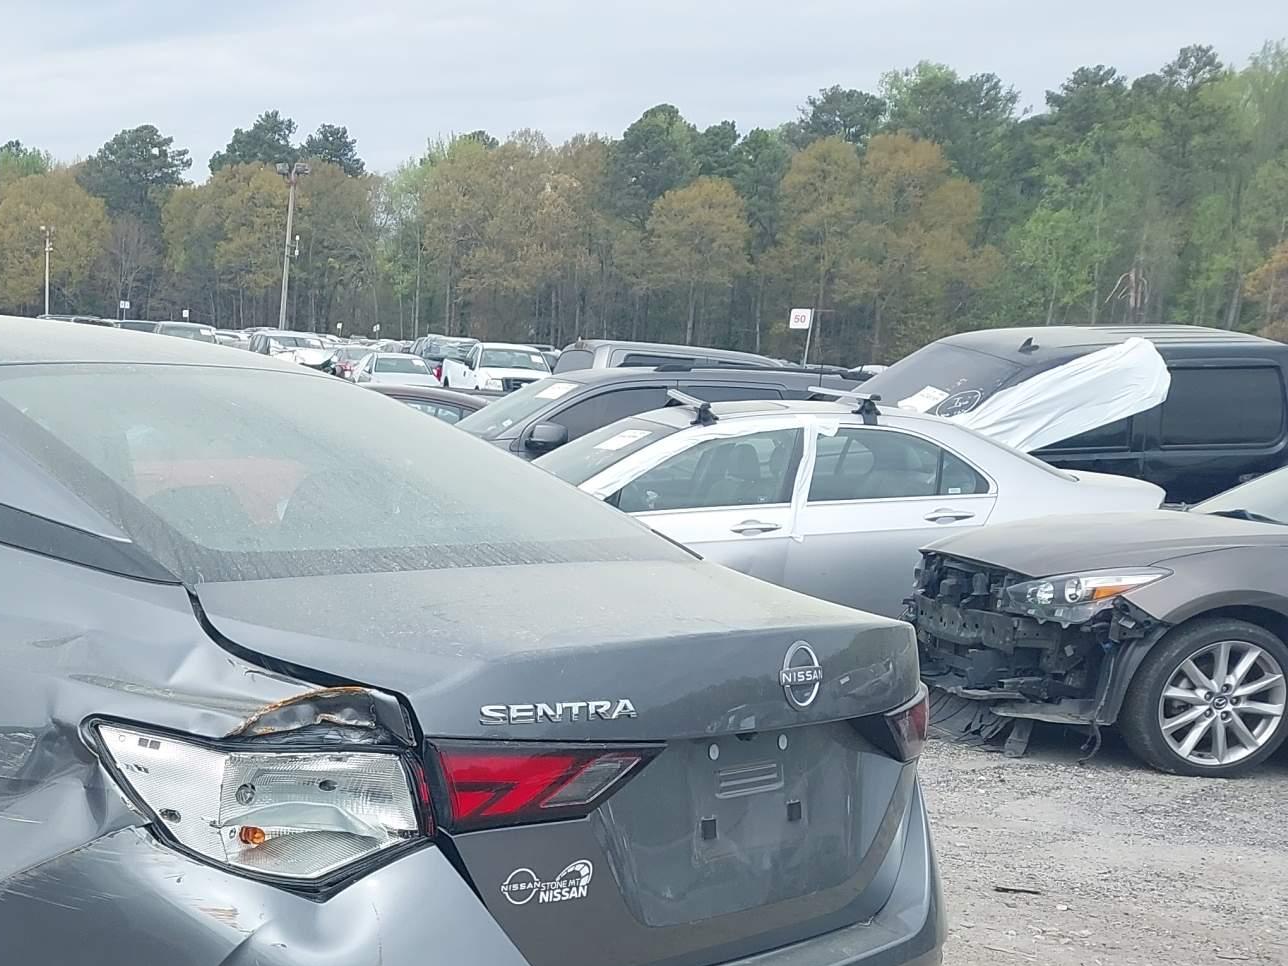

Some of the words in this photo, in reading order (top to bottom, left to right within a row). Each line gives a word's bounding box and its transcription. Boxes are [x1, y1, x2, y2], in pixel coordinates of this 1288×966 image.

[793, 314, 806, 324] 50
[782, 669, 823, 683] NISSAN
[479, 698, 639, 725] SENTRA
[500, 881, 541, 892] NISSAN
[541, 879, 568, 890] STONE
[568, 878, 580, 887] MT
[539, 885, 588, 903] NISSAN
